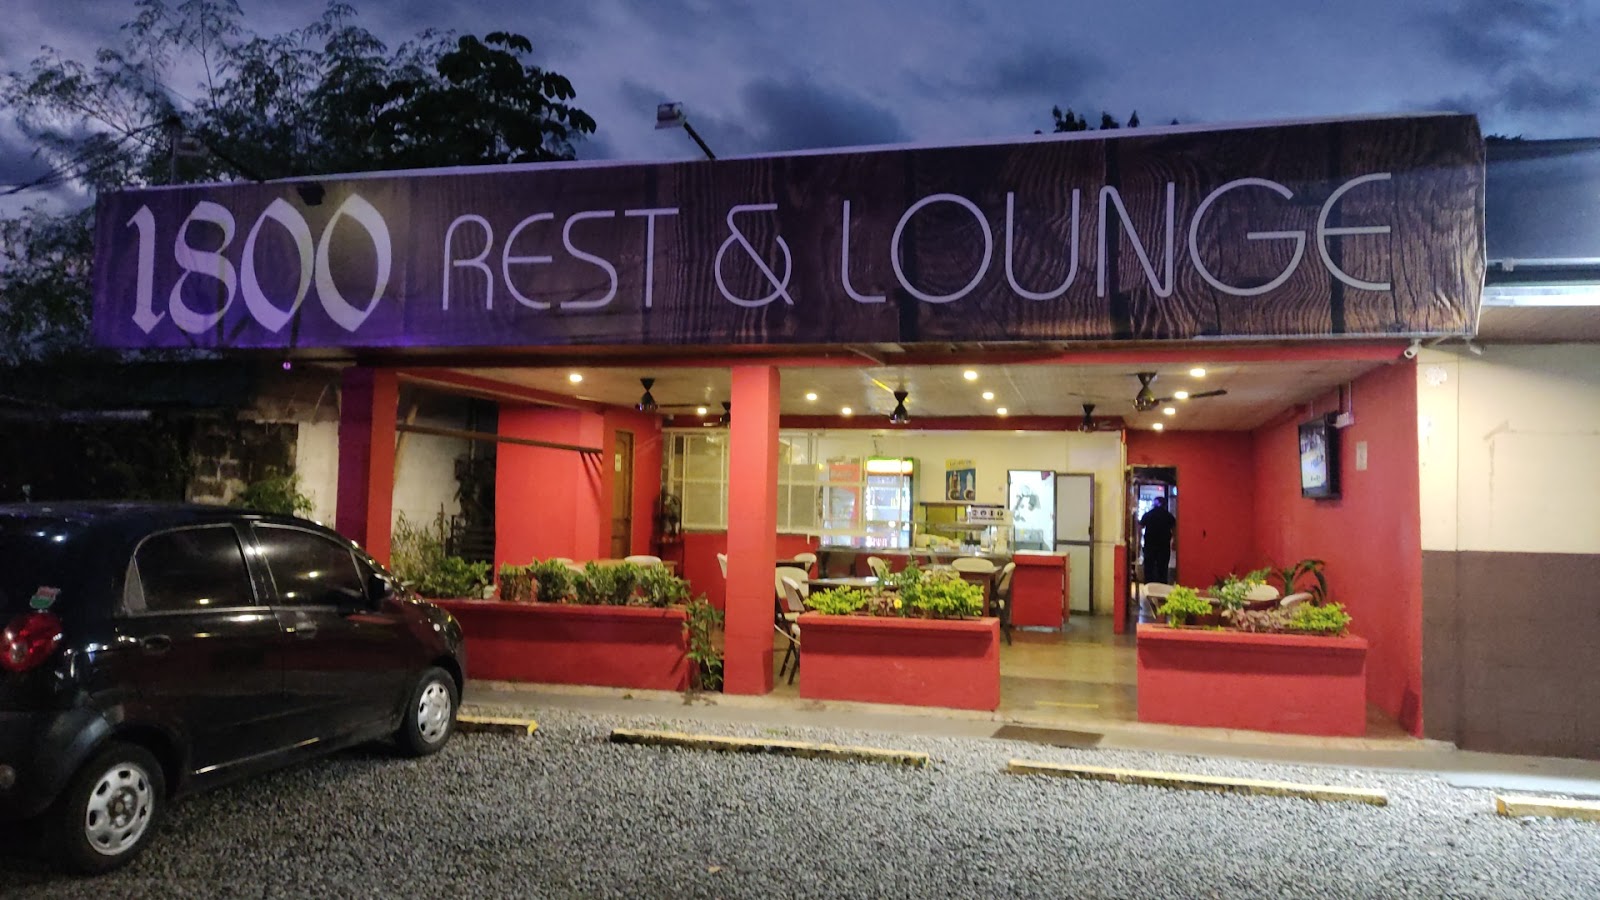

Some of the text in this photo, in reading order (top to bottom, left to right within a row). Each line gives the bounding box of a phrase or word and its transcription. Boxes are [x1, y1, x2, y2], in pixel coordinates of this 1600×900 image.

[125, 172, 1392, 334] 1800 REST & LOUNGE
